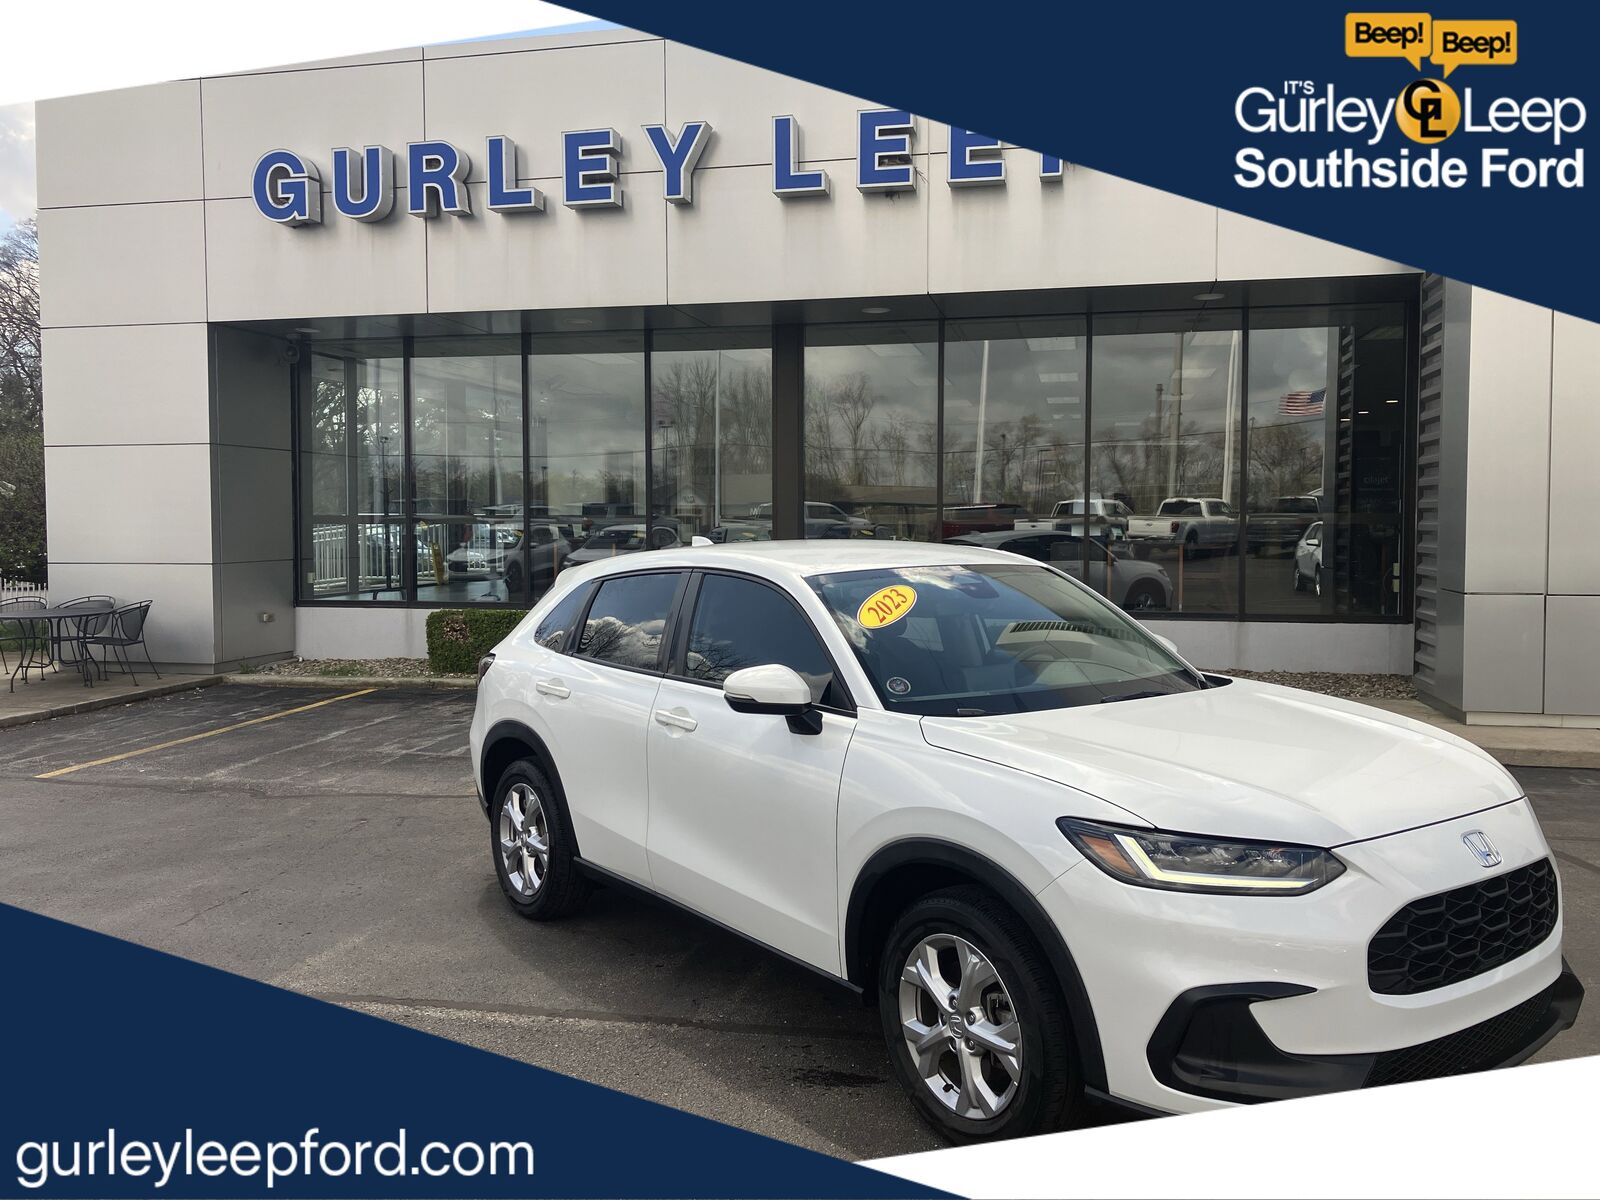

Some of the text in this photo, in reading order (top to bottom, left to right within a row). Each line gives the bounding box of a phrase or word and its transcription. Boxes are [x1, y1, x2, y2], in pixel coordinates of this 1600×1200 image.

[251, 107, 1064, 226] GURLEY LEE
[867, 588, 908, 624] 2023
